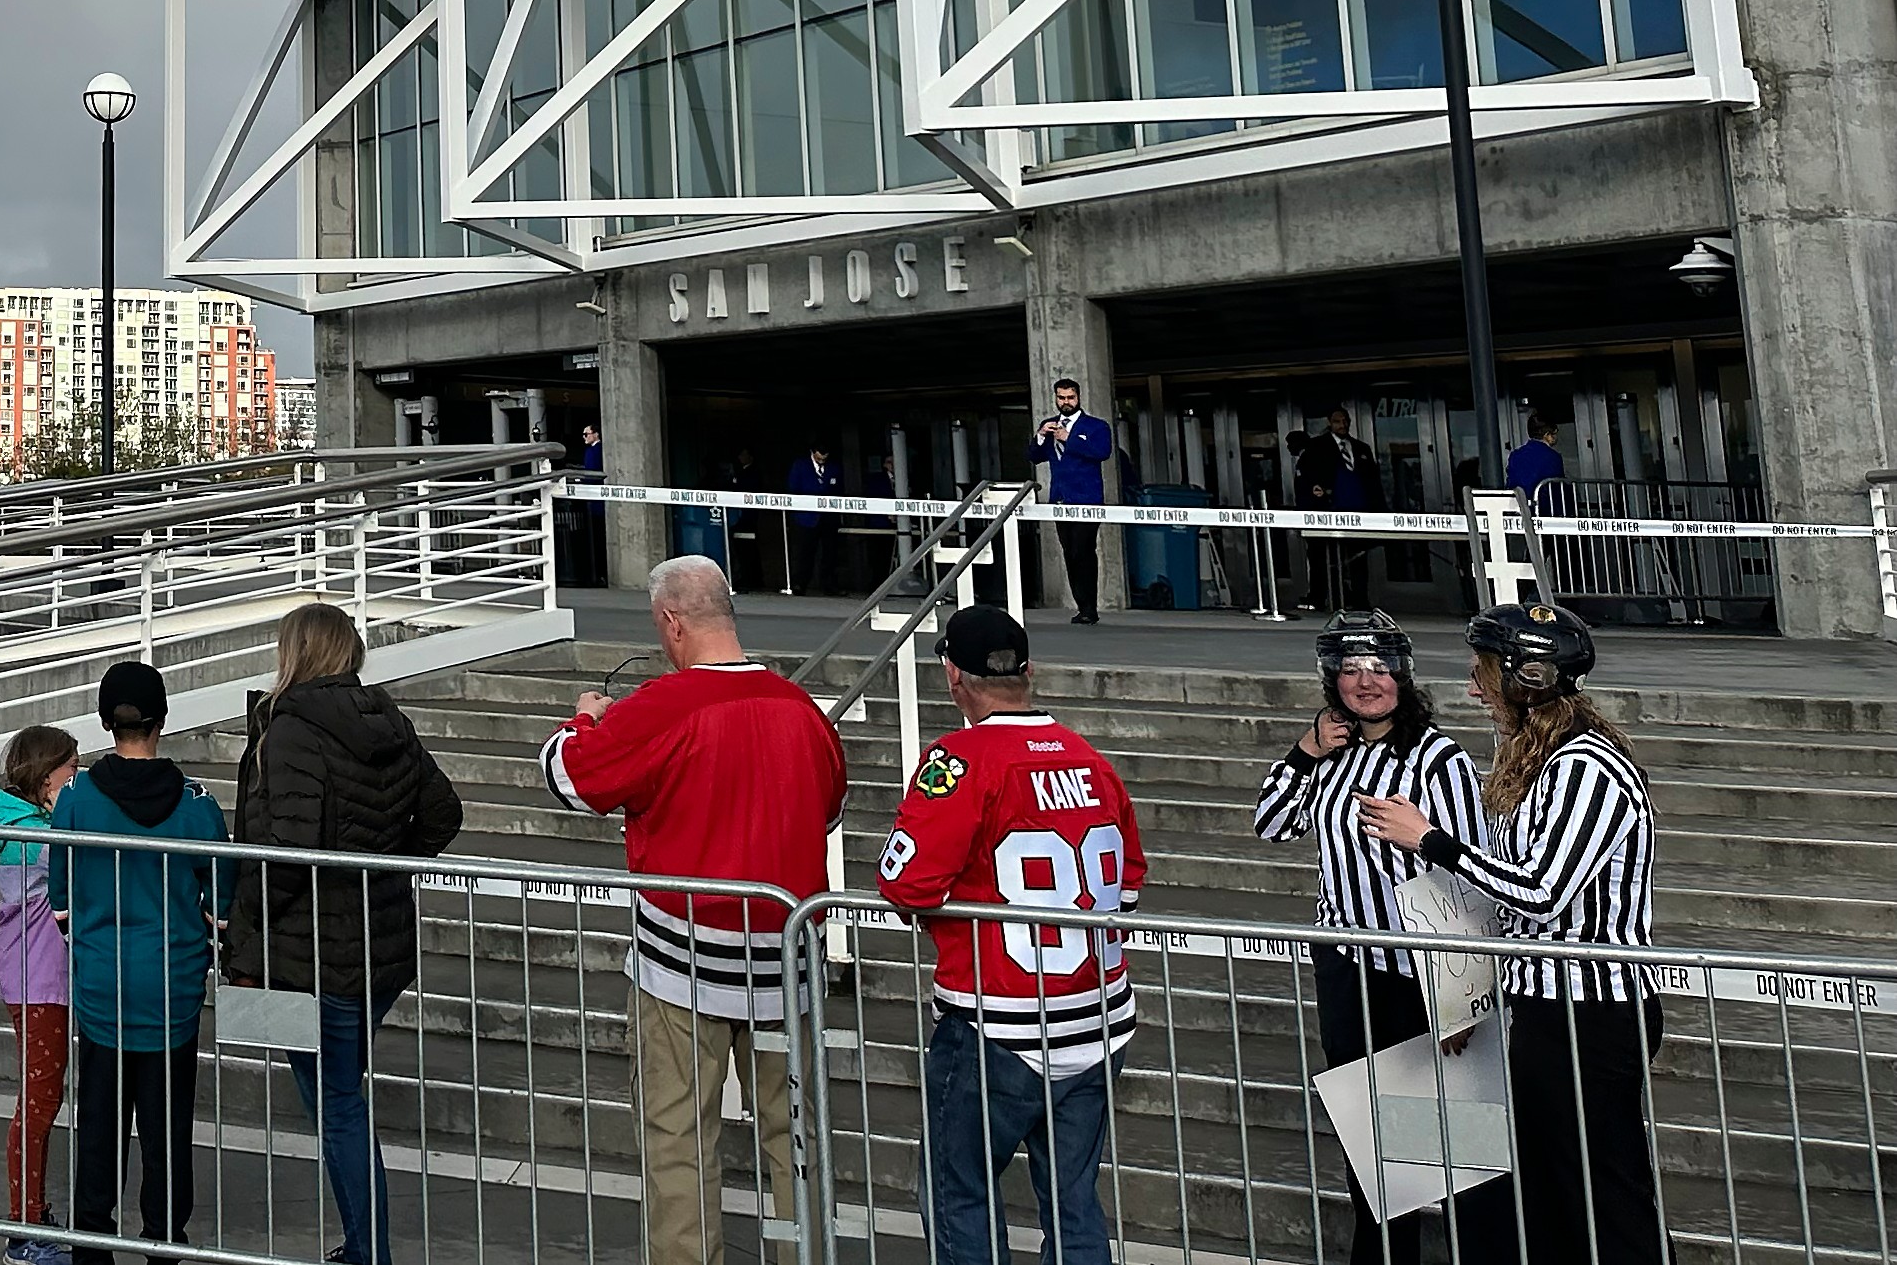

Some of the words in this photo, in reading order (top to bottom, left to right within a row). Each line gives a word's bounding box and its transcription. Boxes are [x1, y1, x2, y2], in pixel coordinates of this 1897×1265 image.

[669, 264, 769, 323] SAN
[803, 236, 969, 309] JOSE
[601, 487, 609, 496] DO
[611, 488, 624, 498] NOT
[626, 488, 646, 499] ENTER
[671, 491, 680, 501] DO
[682, 492, 694, 502] NOT
[696, 493, 717, 503] ENTER
[744, 494, 753, 504] DO
[755, 495, 768, 506] NOT
[770, 495, 792, 506] ENTER
[817, 498, 827, 508] DO
[829, 498, 843, 509] NOT
[845, 499, 867, 510] ENTER
[895, 501, 904, 512] DO
[906, 502, 921, 512] NOT
[923, 503, 945, 514] ENTER
[972, 504, 982, 514] DO
[984, 505, 998, 515] NOT
[1053, 507, 1063, 517] DO
[1065, 507, 1080, 518] NOT
[1082, 508, 1106, 519] ENTER
[1134, 509, 1144, 520] DO
[1146, 510, 1161, 520] NOT
[1164, 510, 1188, 521] ENTER
[1219, 512, 1229, 522] DO
[1232, 512, 1246, 523] NOT
[1250, 513, 1275, 524] ENTER
[1304, 514, 1315, 525] DO
[1317, 514, 1332, 526] NOT
[1335, 515, 1361, 526] ENTER
[1394, 516, 1405, 527] DO
[1407, 517, 1422, 527] NOT
[1425, 518, 1452, 528] ENTER
[1578, 520, 1589, 531] DO
[1592, 521, 1608, 532] NOT
[1611, 521, 1639, 533] ENTER
[1673, 523, 1684, 533] DO
[1686, 524, 1704, 533] NOT
[1707, 524, 1735, 534] ENTER
[1772, 526, 1784, 534] DO
[1787, 526, 1805, 535] NOT
[1808, 527, 1836, 535] ENTER
[1026, 740, 1065, 752] Reebok
[1030, 767, 1100, 811] KANE
[545, 883, 567, 895] NOT
[994, 824, 1123, 975] 88
[1757, 974, 1778, 996] DO
[1784, 974, 1816, 1000] NOT
[1823, 981, 1878, 1007] ENTER
